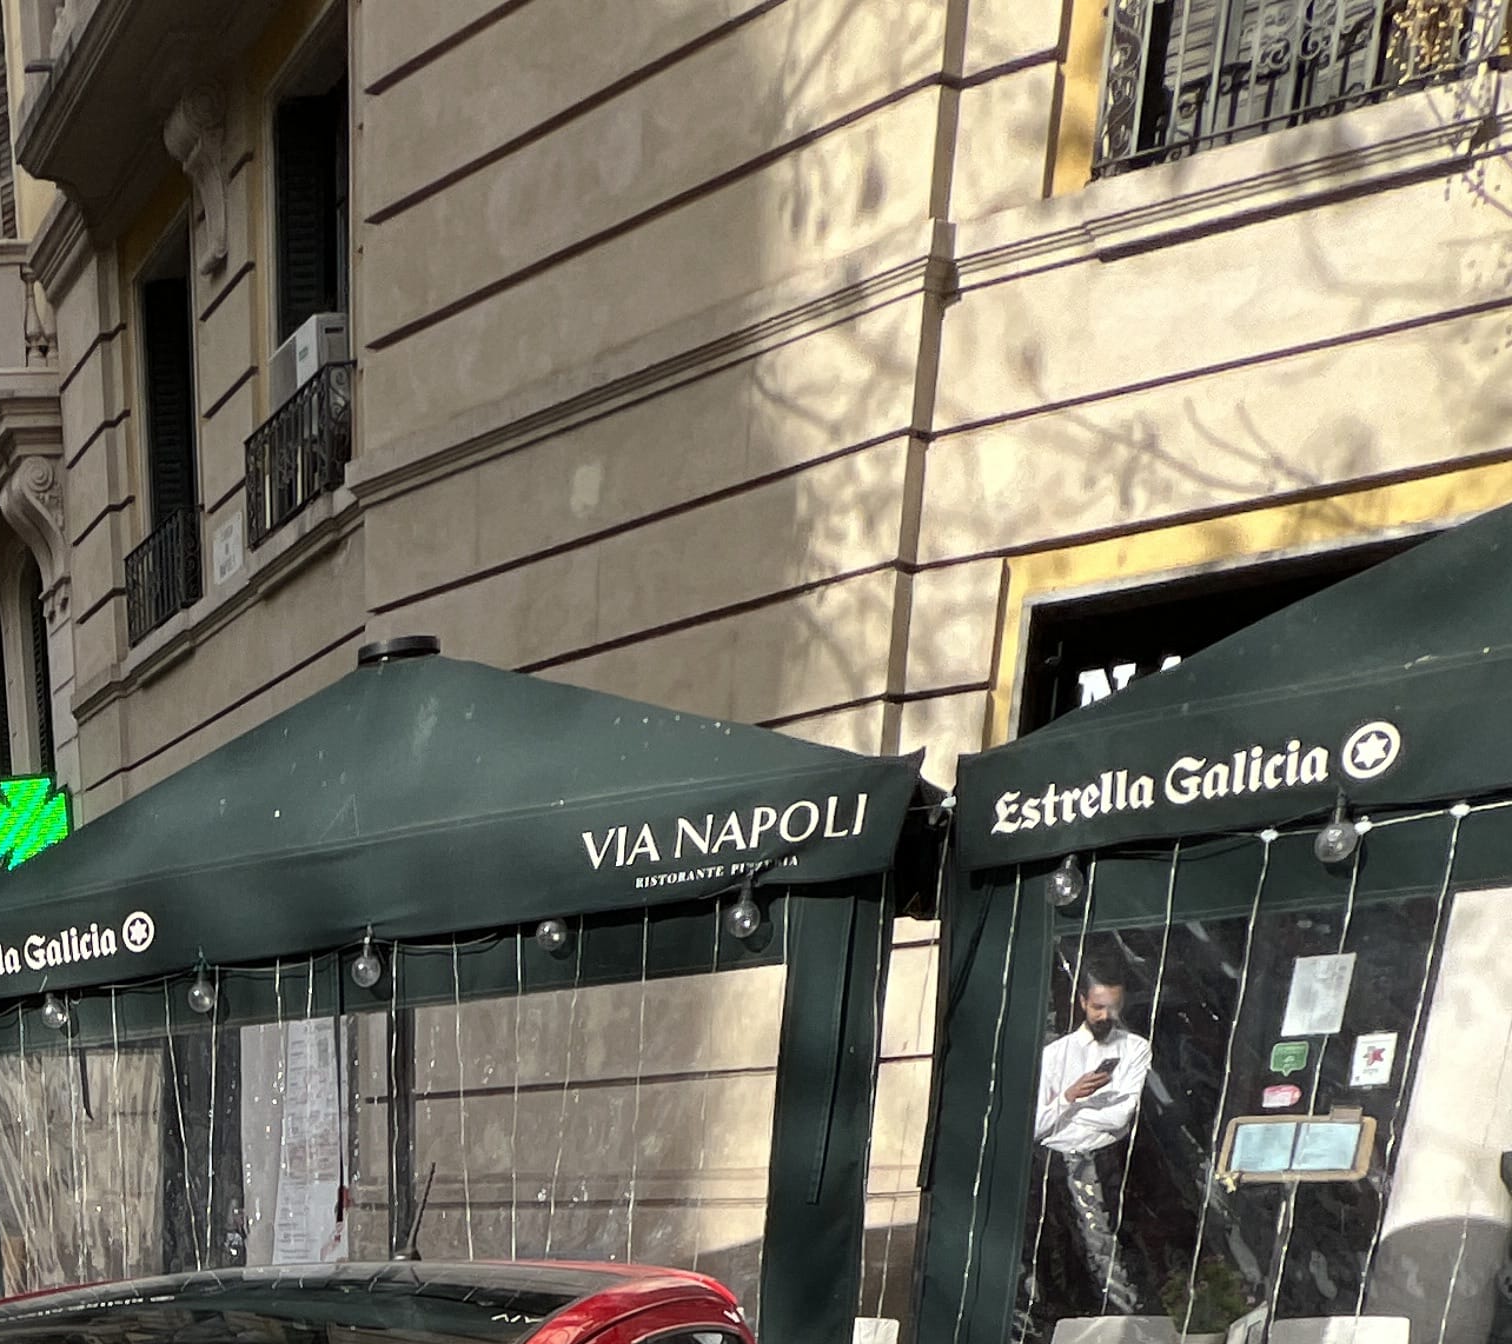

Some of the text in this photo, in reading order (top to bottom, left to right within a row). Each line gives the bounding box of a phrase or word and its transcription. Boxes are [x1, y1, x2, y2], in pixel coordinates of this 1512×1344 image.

[990, 739, 1329, 835] Estrella Galicia
[582, 793, 868, 870] VIA NAPOLI
[635, 865, 724, 888] RISTORANTE
[24, 922, 118, 970] Galicia
